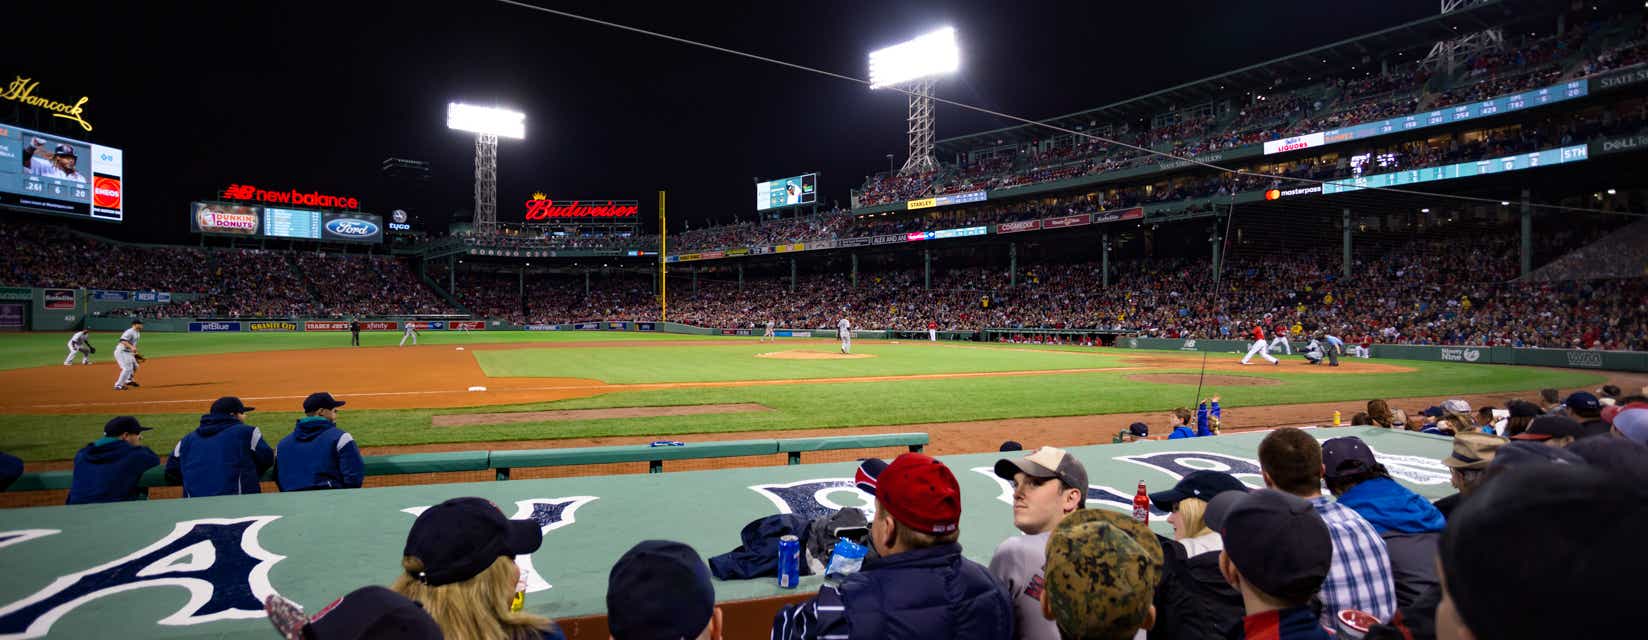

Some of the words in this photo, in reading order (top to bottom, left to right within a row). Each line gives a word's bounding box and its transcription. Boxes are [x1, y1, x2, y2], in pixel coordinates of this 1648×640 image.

[1, 76, 93, 131] Hancock
[1603, 139, 1636, 152] DELL
[95, 187, 119, 198] ENEOS
[1281, 186, 1322, 198] masterpass
[255, 190, 291, 204] new
[291, 189, 359, 209] balance
[525, 199, 638, 220] Budweiser
[216, 221, 253, 230] DONUTS
[335, 222, 367, 236] Ford
[389, 223, 410, 231] tyco
[201, 322, 230, 331] jetBlue
